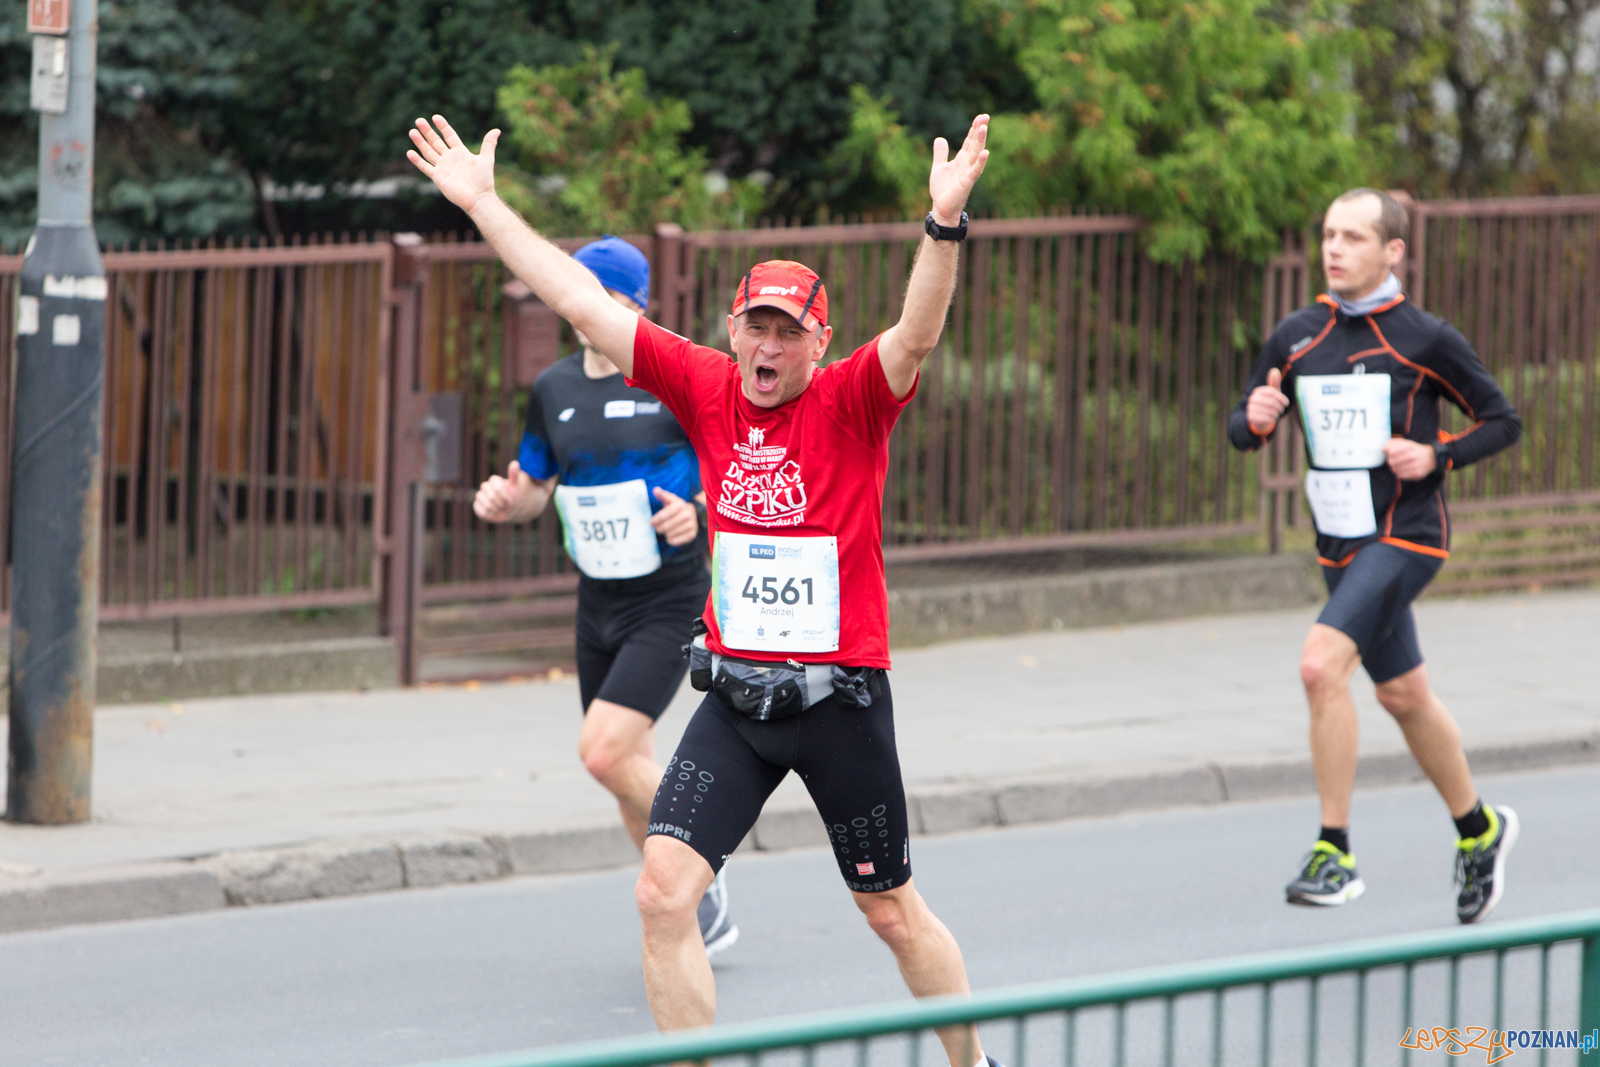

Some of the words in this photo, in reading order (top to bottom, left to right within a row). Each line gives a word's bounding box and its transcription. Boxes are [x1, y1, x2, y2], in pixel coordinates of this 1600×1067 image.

[1319, 408, 1368, 431] 3771
[720, 480, 807, 515] SZPIKU
[580, 518, 629, 541] 3817
[760, 548, 774, 556] PKO
[742, 576, 813, 605] 4561
[760, 607, 794, 617] Andrzej
